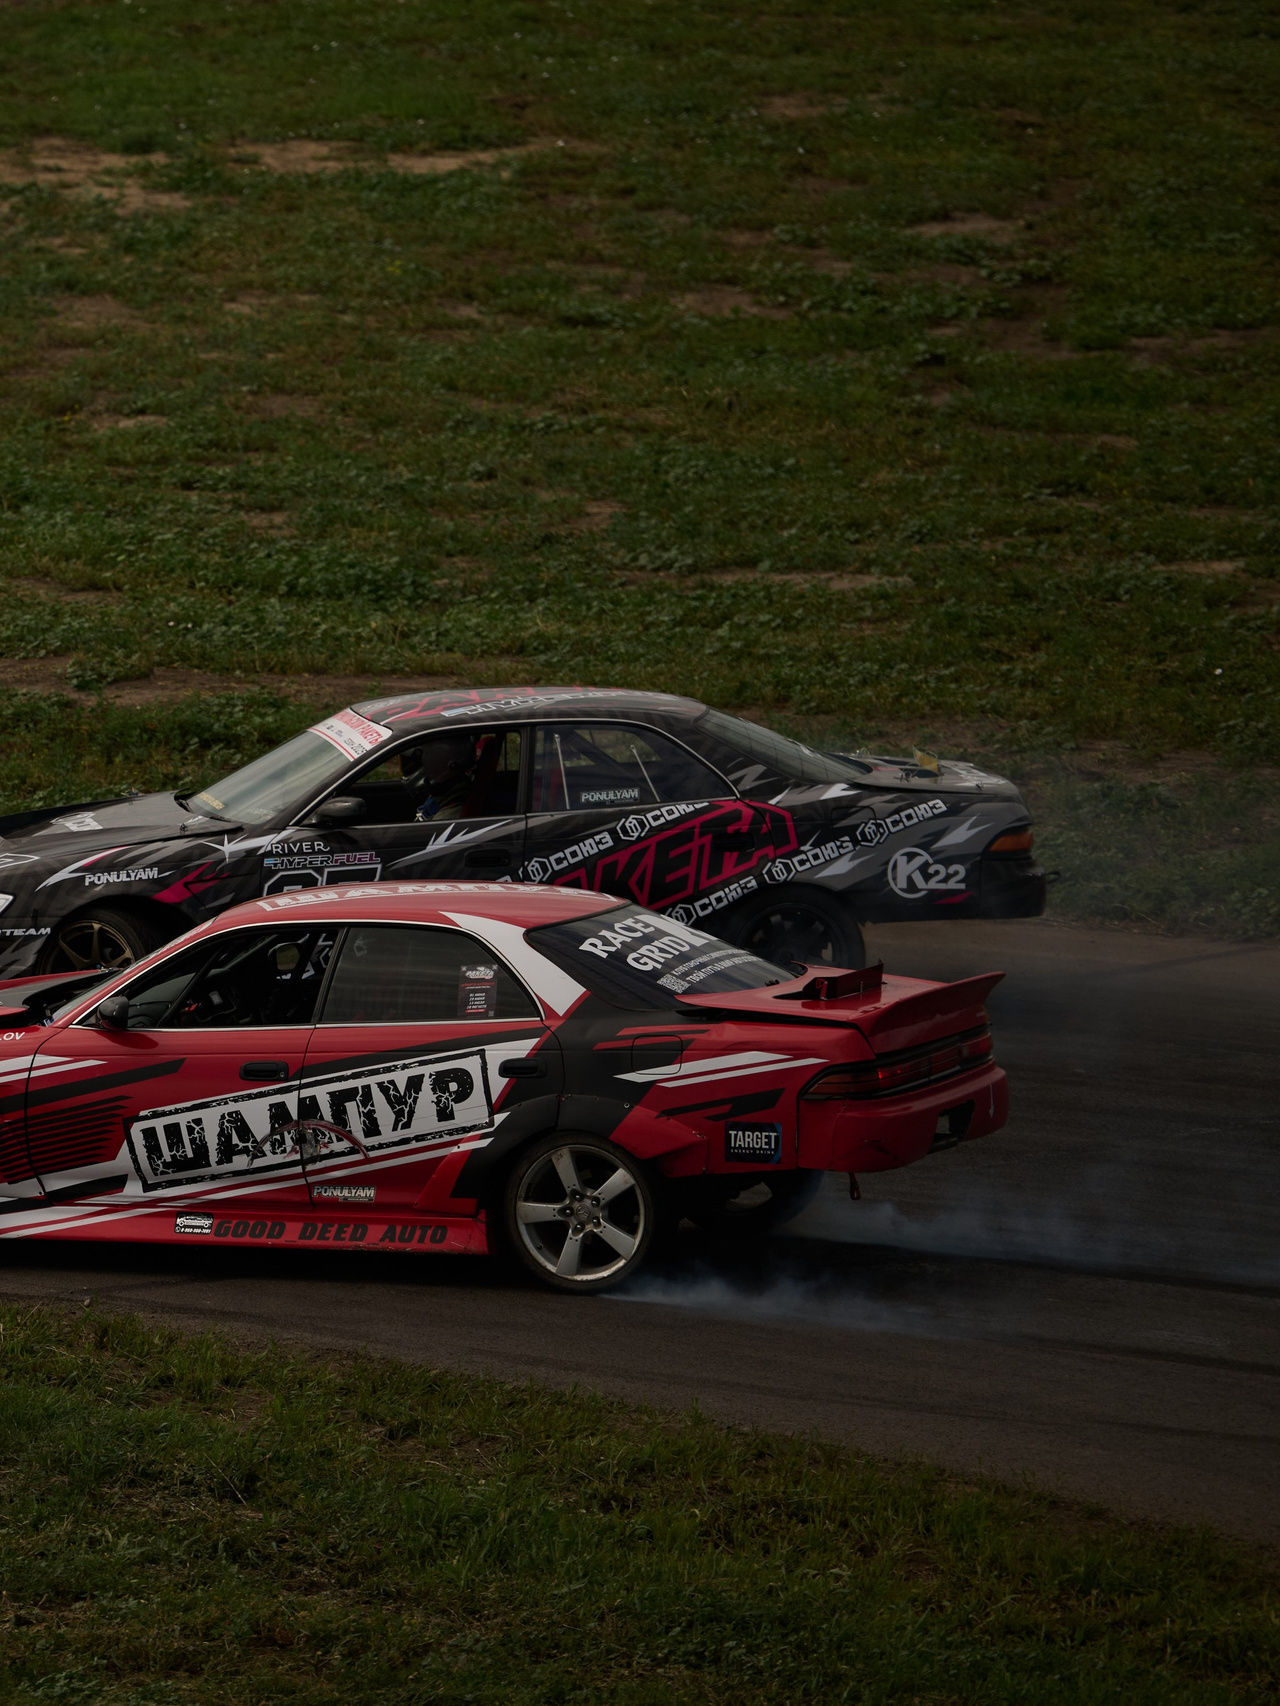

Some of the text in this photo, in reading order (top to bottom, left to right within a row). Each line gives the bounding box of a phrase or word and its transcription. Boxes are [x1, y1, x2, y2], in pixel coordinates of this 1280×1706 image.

[581, 788, 639, 802] PONULYAM
[886, 798, 948, 834] СОЮЗ
[272, 841, 330, 855] RIVER
[549, 831, 614, 871] СОЮЗ
[794, 836, 854, 872] СОЮЗ
[84, 867, 159, 886] PONULYAM
[696, 875, 759, 918] СОЮЗ
[579, 917, 656, 958] RACE
[626, 935, 691, 971] GRID
[140, 1067, 475, 1177] ШАМПУР
[728, 1130, 779, 1149] TARGET
[313, 1184, 376, 1197] PONULYAM
[214, 1220, 448, 1244] GOOD DEED AUTO
